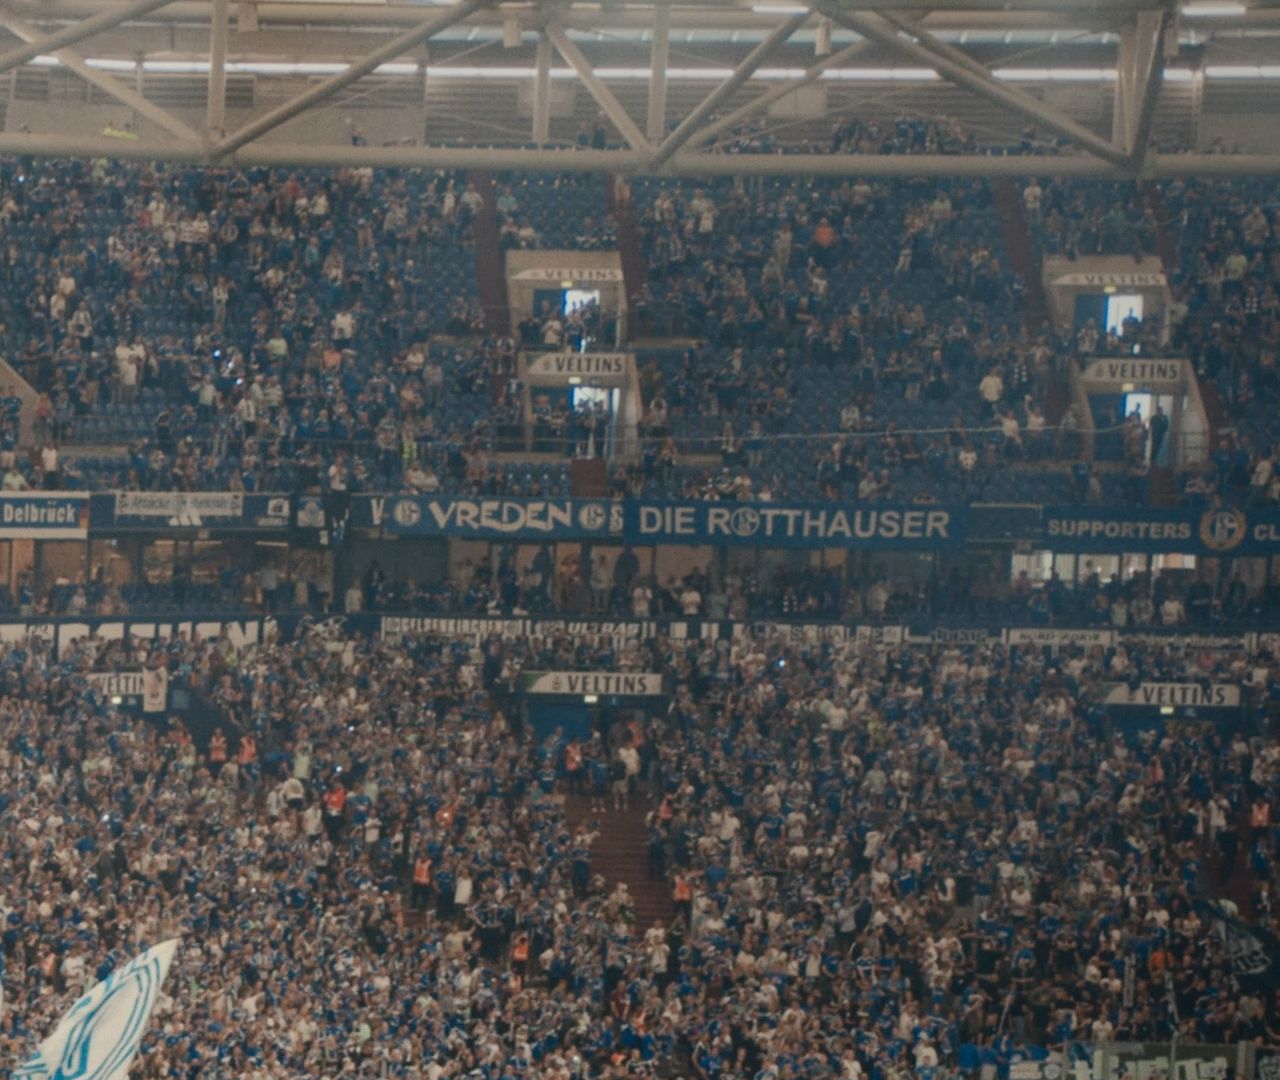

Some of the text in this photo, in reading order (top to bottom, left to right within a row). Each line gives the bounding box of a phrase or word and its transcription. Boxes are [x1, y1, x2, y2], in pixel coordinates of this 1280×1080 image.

[545, 270, 617, 280] VELTINS
[1085, 275, 1160, 285] VELTINS
[556, 356, 622, 373] VELTINS
[1109, 363, 1178, 380] VELTINS
[3, 500, 76, 523] Delbrück
[428, 500, 572, 532] VREDEN
[639, 506, 696, 535] DIE
[1048, 519, 1191, 539] SUPPORTERS
[97, 675, 145, 696] VELTI
[568, 675, 648, 692] VELTINS
[1142, 685, 1226, 704] VELTINS
